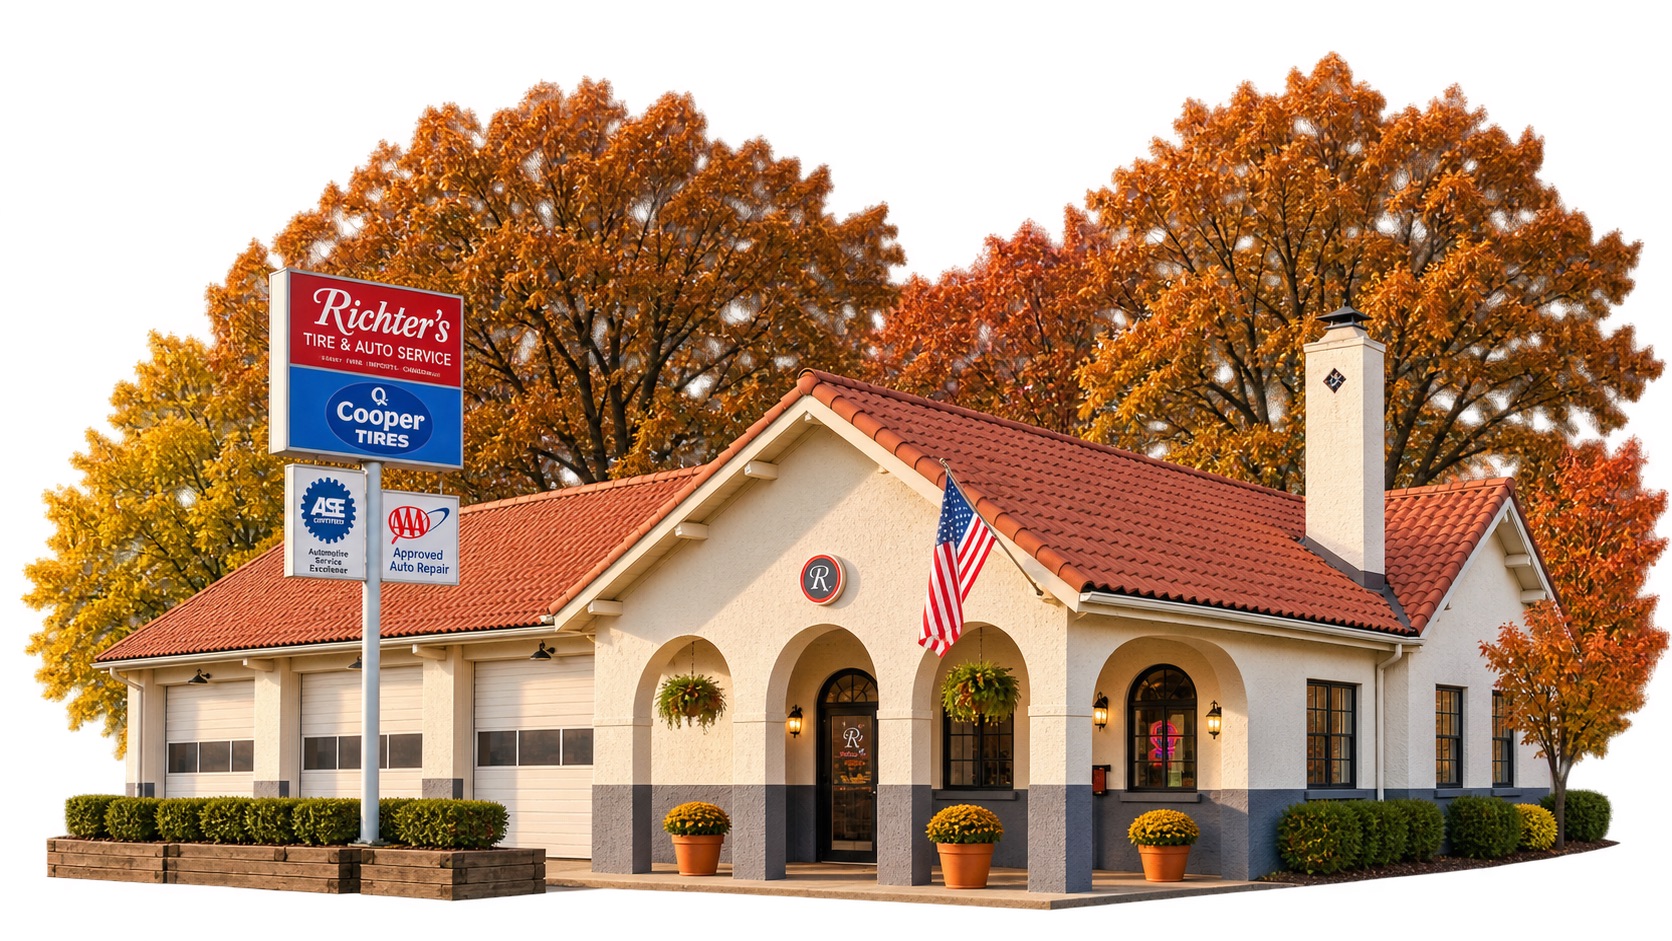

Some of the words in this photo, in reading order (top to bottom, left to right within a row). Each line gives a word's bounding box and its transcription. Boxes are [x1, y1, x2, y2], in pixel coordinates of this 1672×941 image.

[313, 287, 450, 343] Richter's
[303, 332, 336, 349] TIRE
[340, 338, 351, 352] &
[355, 340, 393, 357] AUTO
[397, 346, 452, 366] SERVICE
[336, 401, 425, 431] Cooper
[355, 429, 409, 448] TIRES
[310, 496, 346, 518] ASE
[391, 507, 425, 537] AAA
[393, 547, 443, 561] Approved
[389, 561, 414, 572] Auto
[417, 562, 450, 576] Repair
